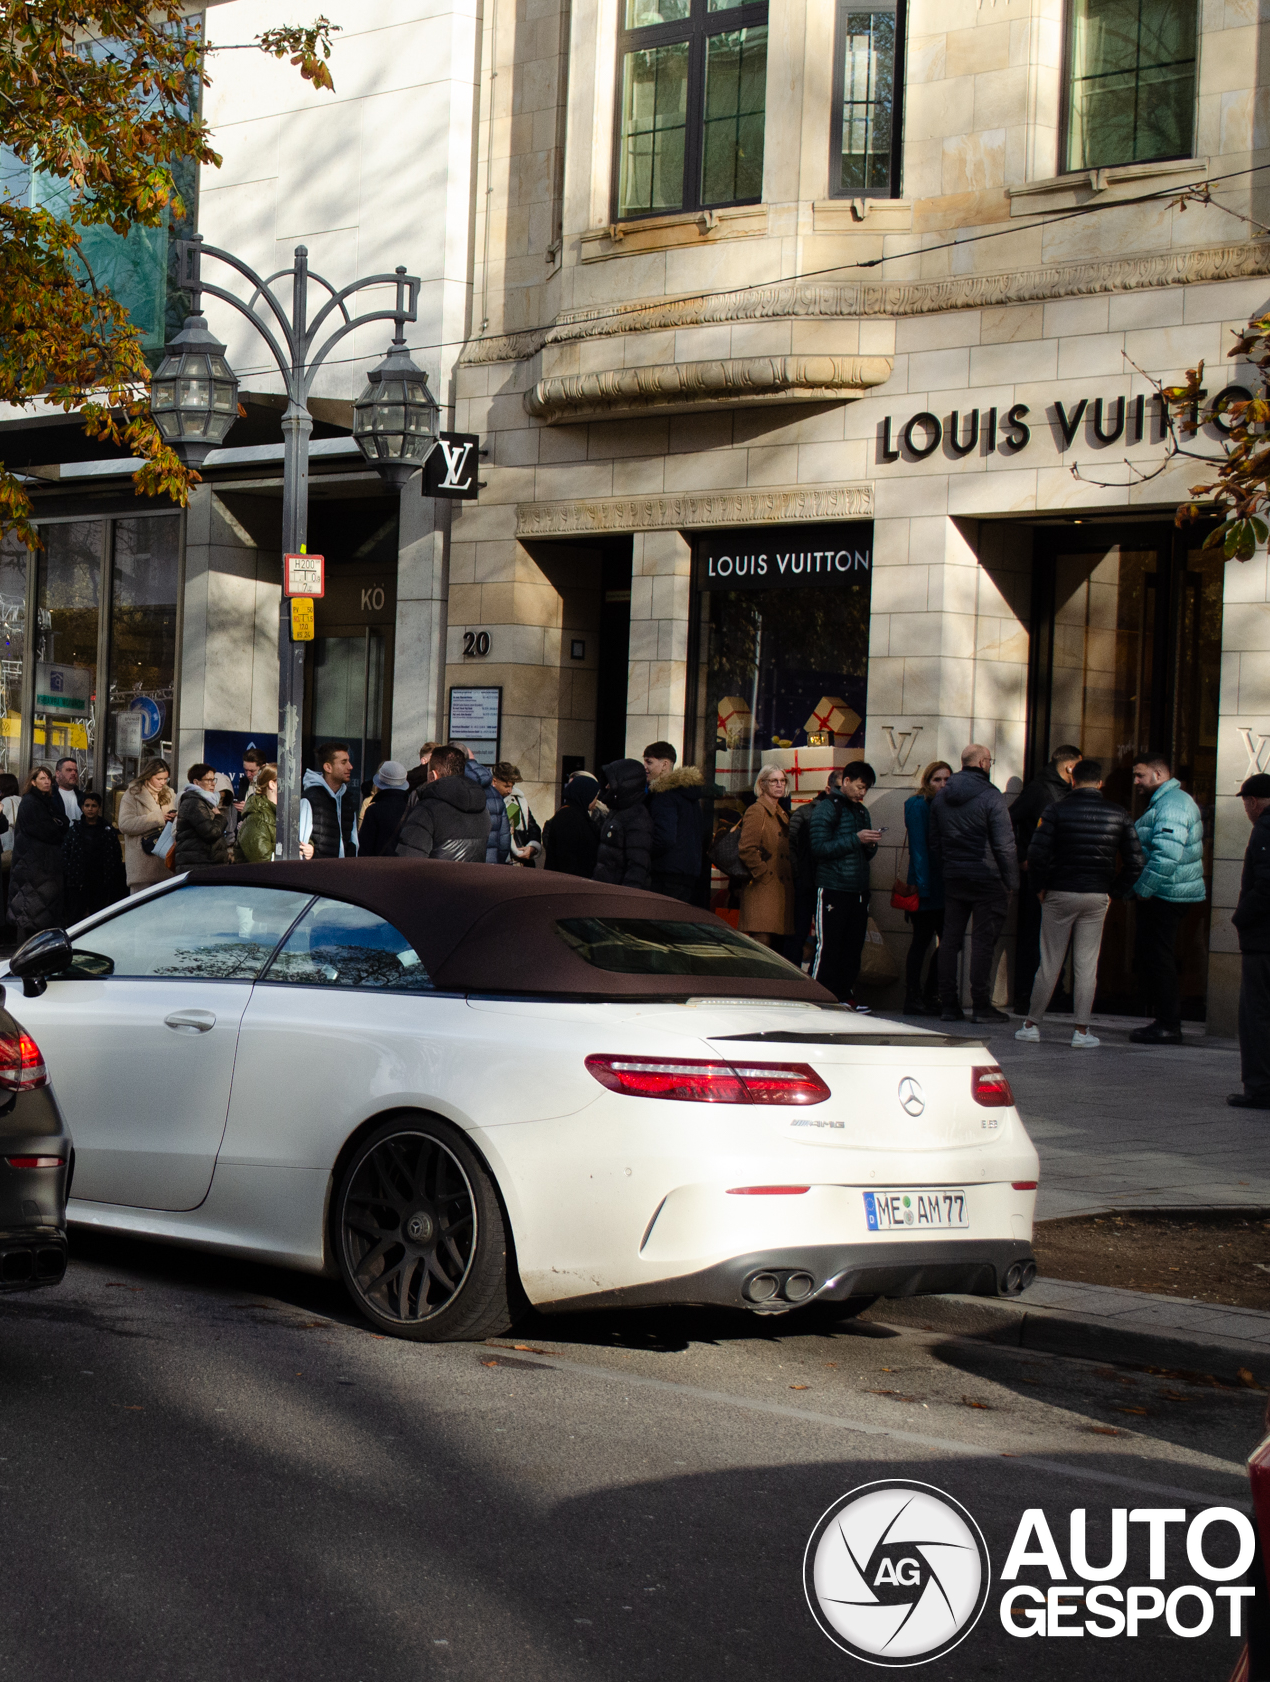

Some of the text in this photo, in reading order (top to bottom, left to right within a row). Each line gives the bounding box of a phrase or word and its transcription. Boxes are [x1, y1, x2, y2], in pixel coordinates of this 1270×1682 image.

[883, 385, 1270, 459] LOUIS VUITTO
[708, 550, 869, 577] LOUIS VUITTON
[463, 631, 491, 655] 20
[876, 1197, 905, 1225] ME
